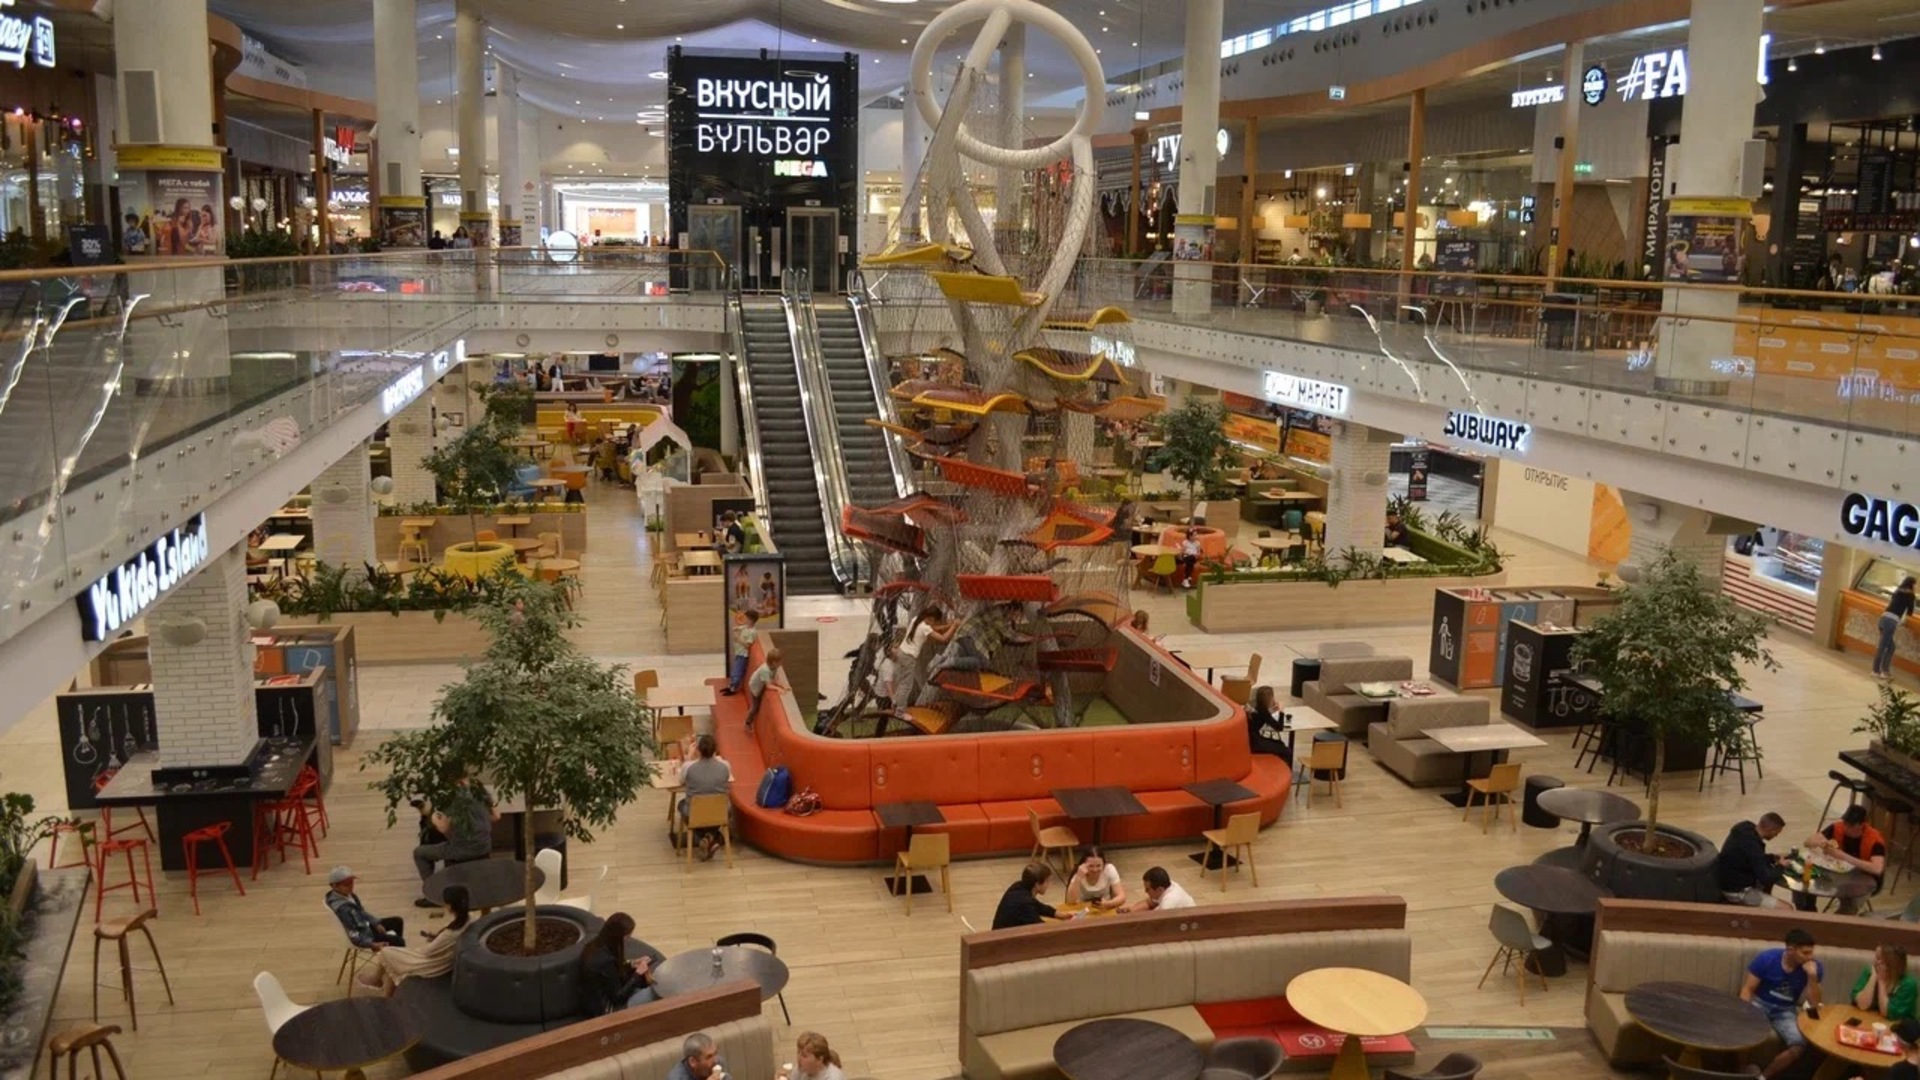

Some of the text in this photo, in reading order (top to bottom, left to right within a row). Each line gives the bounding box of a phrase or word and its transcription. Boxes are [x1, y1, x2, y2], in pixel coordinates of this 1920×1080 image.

[697, 75, 831, 112] ВКУСНЫЙ
[697, 123, 831, 156] БУЛЬВАР
[773, 159, 829, 178] MEGA
[1645, 157, 1663, 258] МИРАТОРГ
[1443, 410, 1527, 451] SUBWAY
[1524, 467, 1569, 491] ОТКРЫТИЕ
[1841, 492, 1920, 550] GAG
[91, 510, 209, 642] Yu Kids Island
